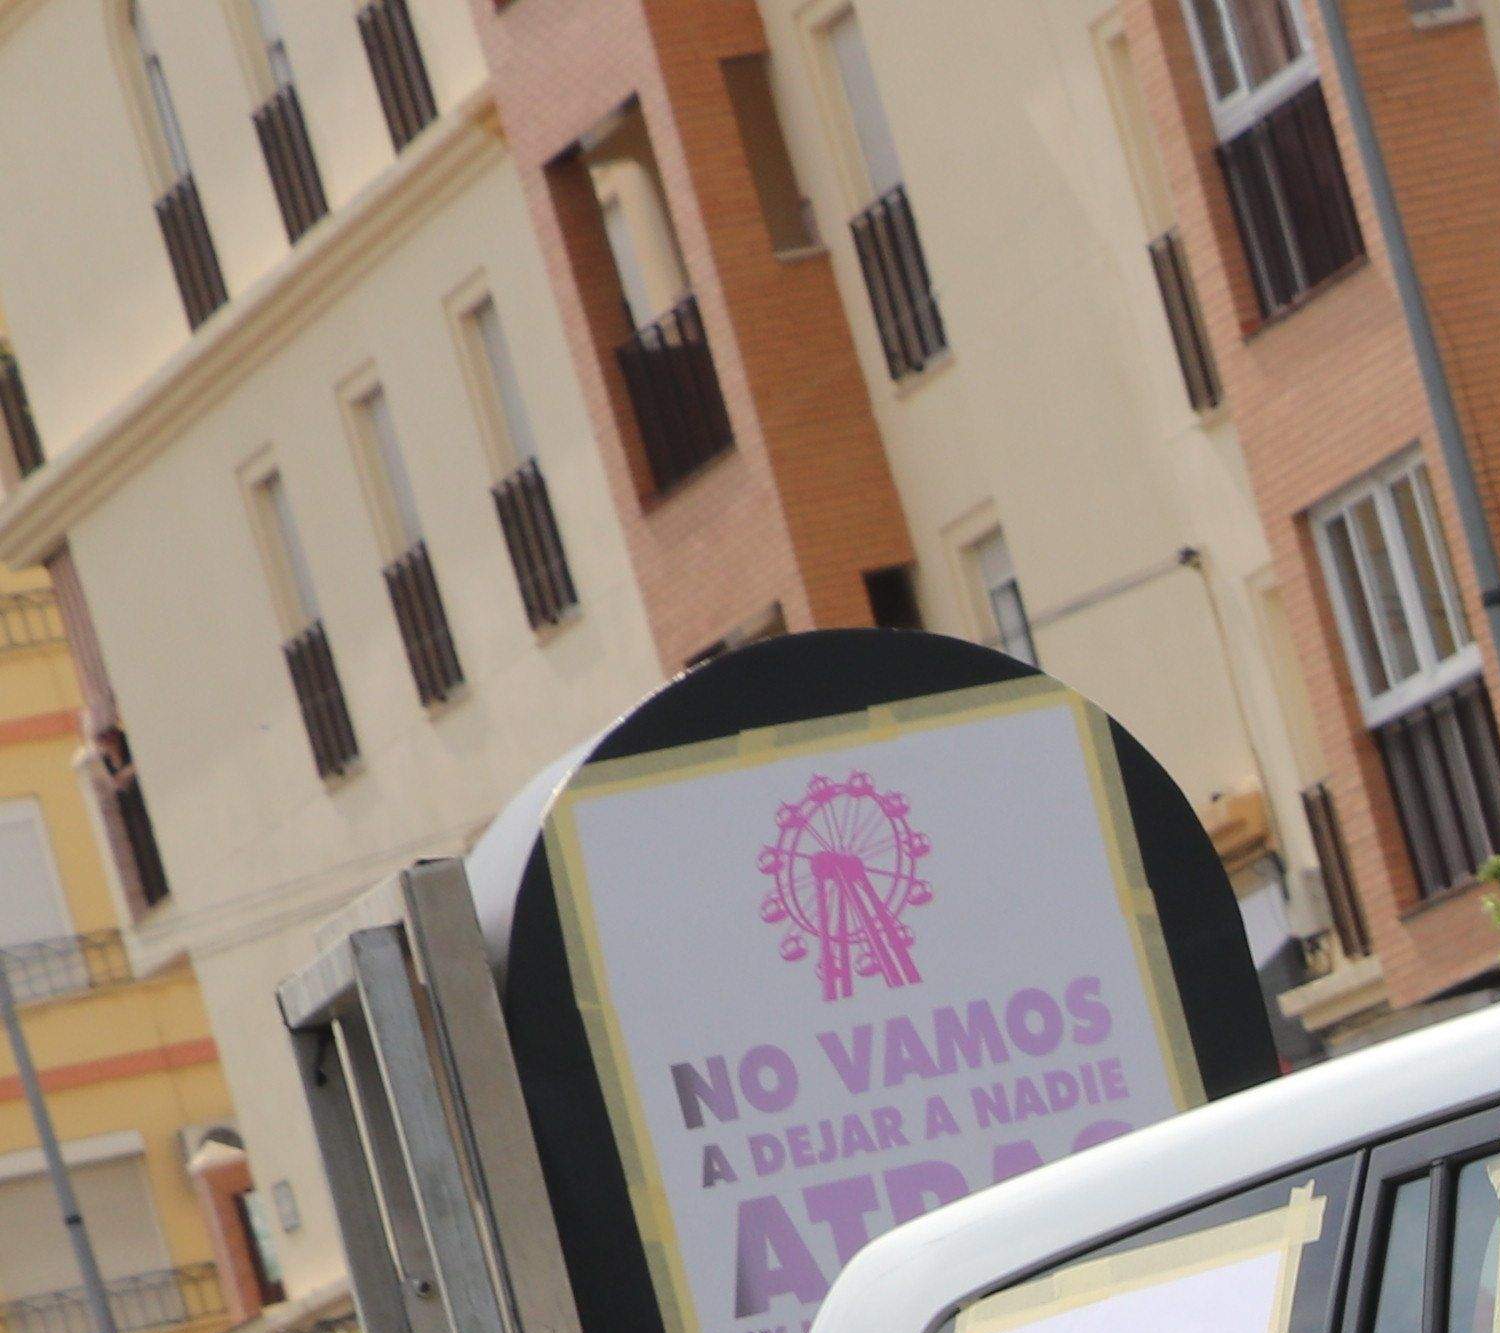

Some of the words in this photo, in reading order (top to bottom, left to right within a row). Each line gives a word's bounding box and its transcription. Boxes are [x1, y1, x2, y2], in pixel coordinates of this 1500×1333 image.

[669, 1043, 800, 1130] NO
[815, 975, 1114, 1097] VAMOS
[701, 1142, 739, 1189] A
[746, 1104, 911, 1178] DEJAR
[925, 1094, 961, 1141] A
[969, 1057, 1131, 1130] NADIE
